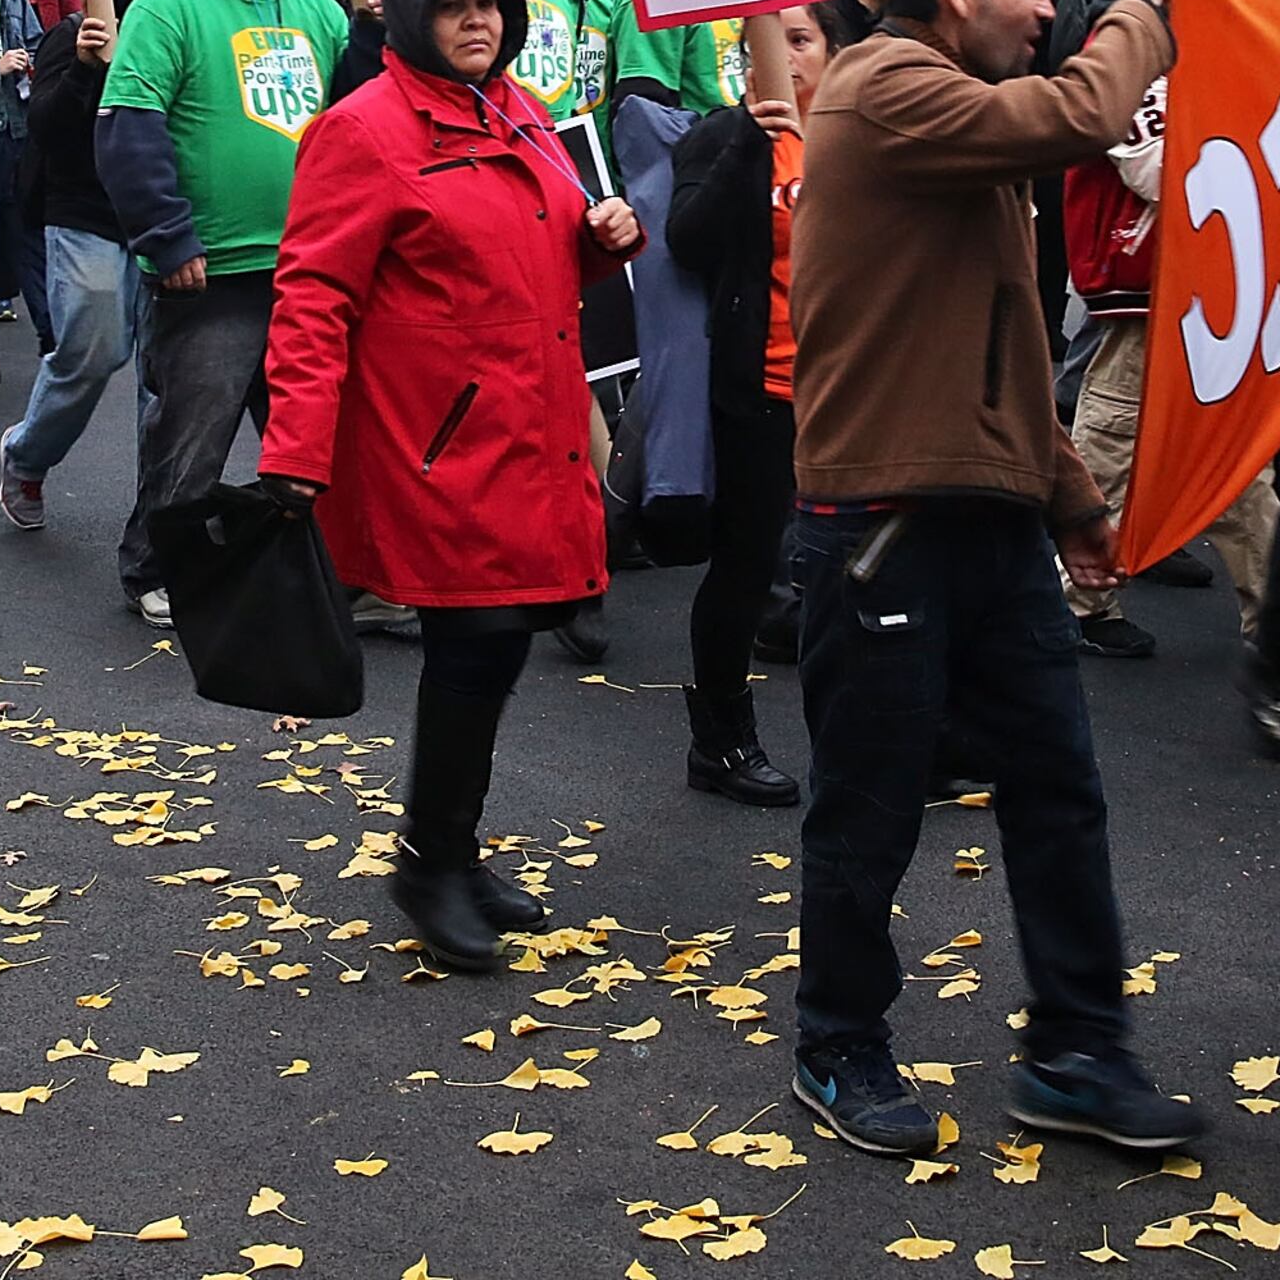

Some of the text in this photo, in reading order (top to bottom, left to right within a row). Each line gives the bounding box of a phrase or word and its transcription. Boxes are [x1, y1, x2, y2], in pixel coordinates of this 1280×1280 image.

[250, 32, 295, 51] END
[516, 51, 568, 87] ups
[251, 86, 319, 125] ups
